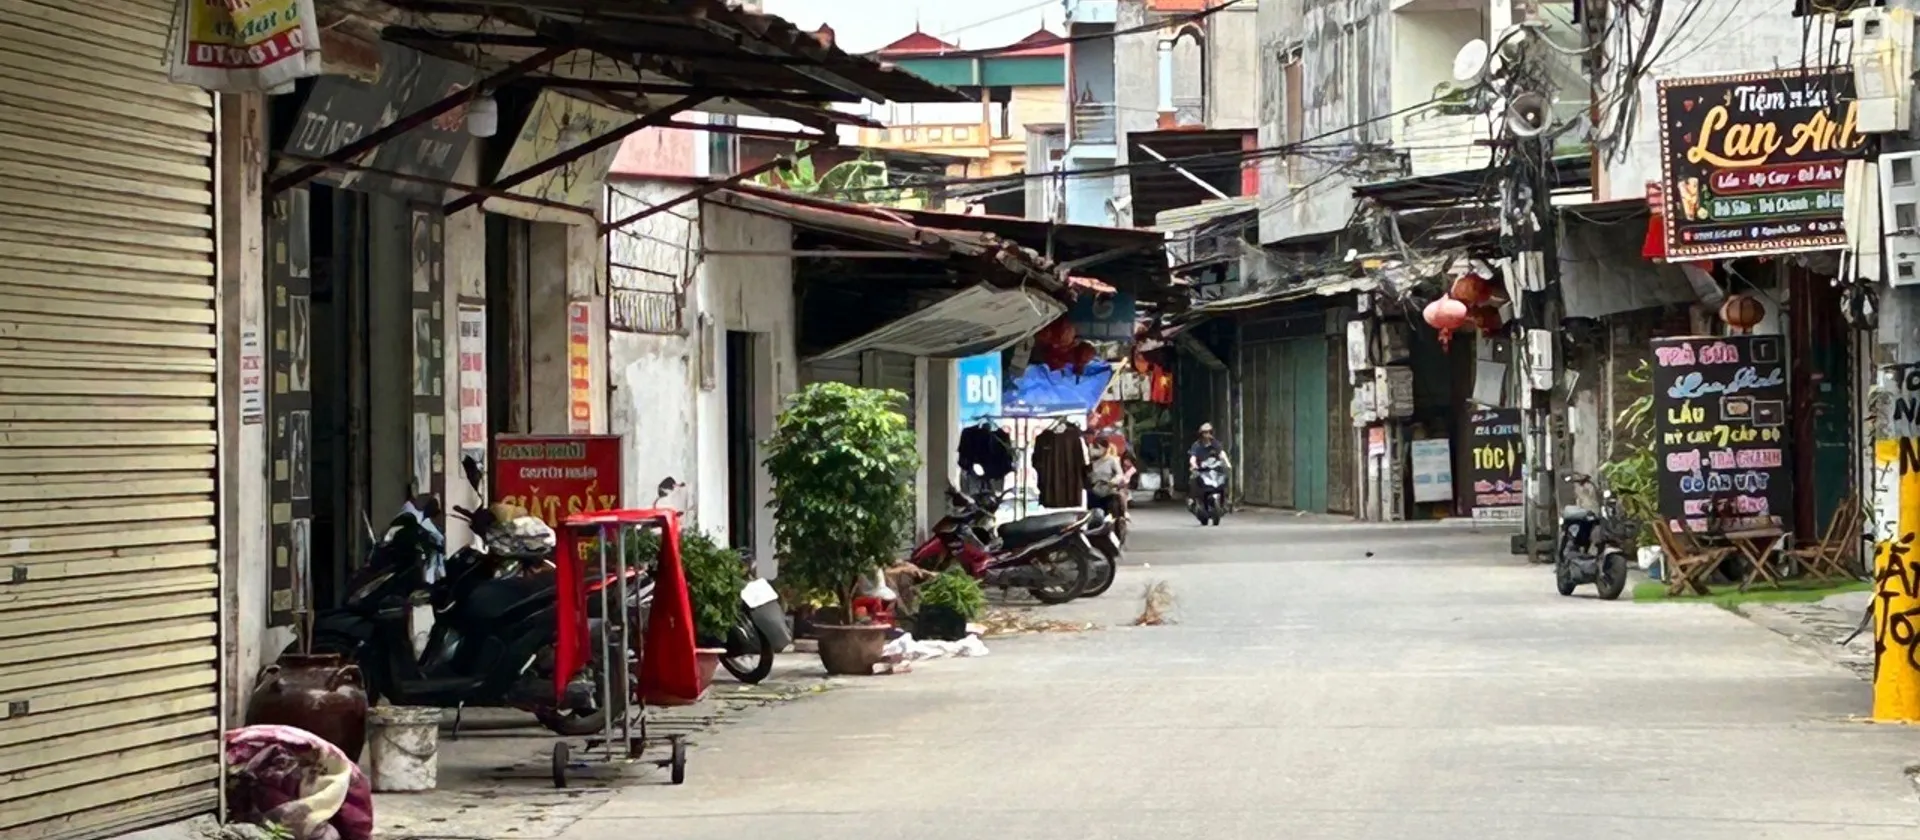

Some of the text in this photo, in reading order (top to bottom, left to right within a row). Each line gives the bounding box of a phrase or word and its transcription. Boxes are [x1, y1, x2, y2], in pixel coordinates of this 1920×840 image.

[1734, 86, 1786, 116] Tiệm
[1688, 105, 1783, 168] Lan
[1655, 342, 1696, 367] TRÀ
[1713, 425, 1730, 447] 7
[1473, 443, 1505, 470] TÓC
[1736, 448, 1782, 468] CHANH
